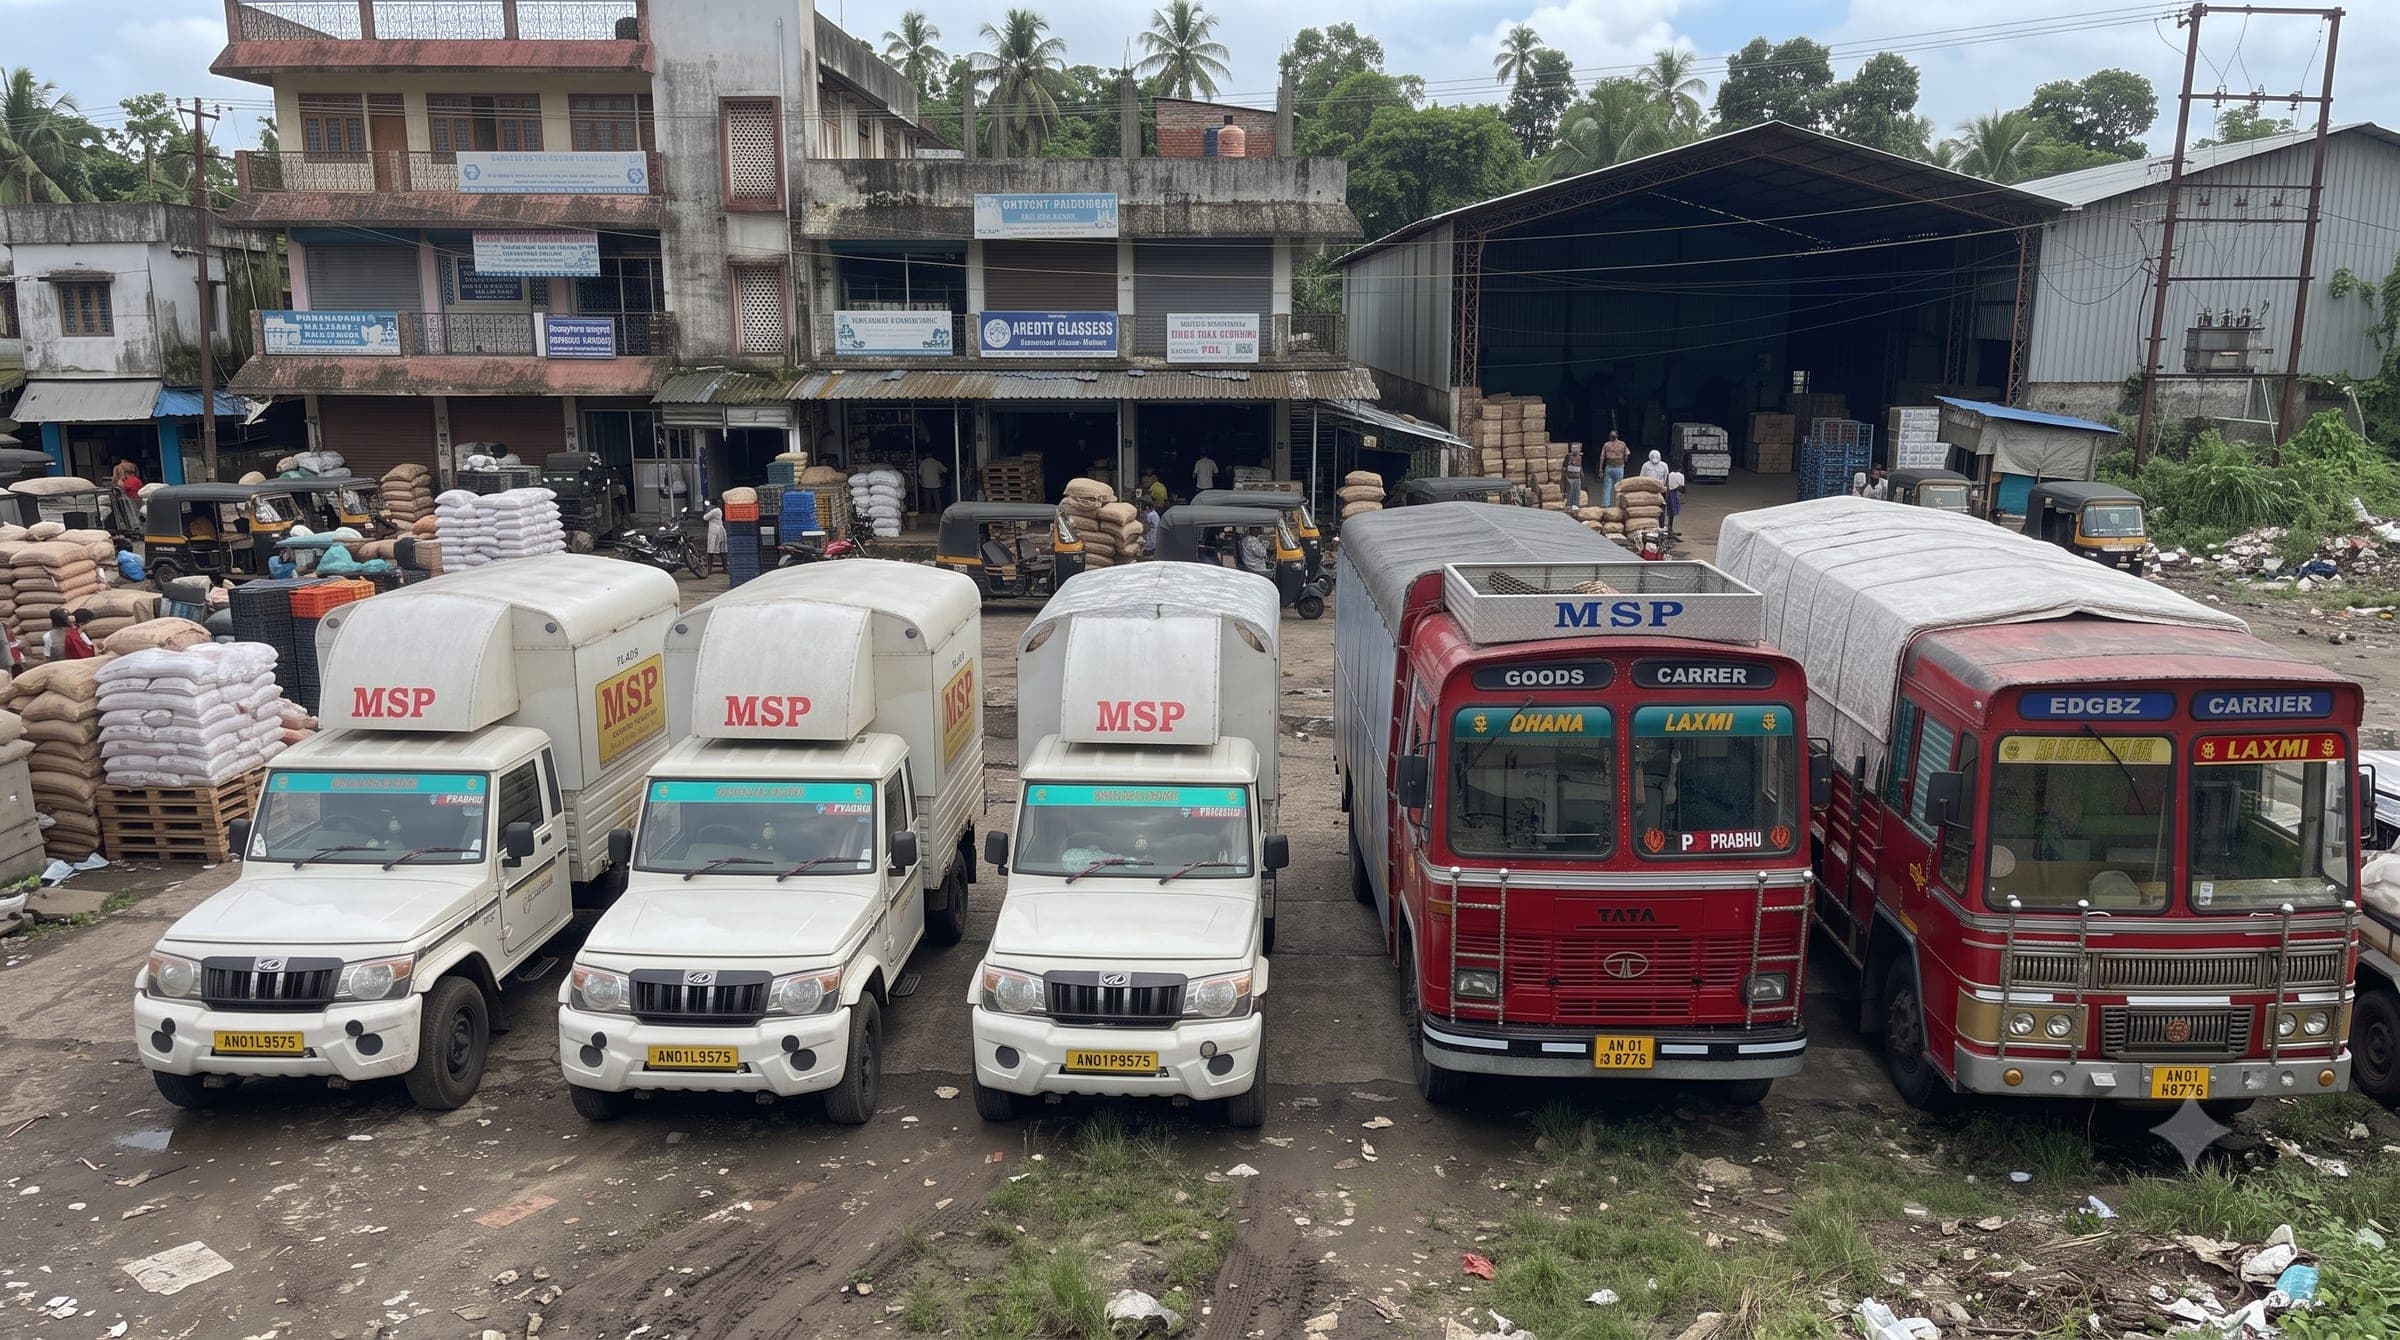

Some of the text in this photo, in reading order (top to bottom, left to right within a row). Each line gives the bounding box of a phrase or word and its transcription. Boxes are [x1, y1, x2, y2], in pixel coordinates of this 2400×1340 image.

[1554, 601, 1684, 628] MSP
[1505, 668, 1747, 685] GOODS CARRER
[351, 687, 436, 718] MSP
[602, 665, 659, 731] MSP
[945, 670, 972, 734] MSP
[2050, 696, 2313, 715] EDGBZ CARRIER
[724, 695, 812, 728] MSP
[1096, 700, 1186, 733] MSP
[1509, 712, 1735, 733] DHANA LAXMI
[2226, 739, 2310, 760] LAXMI
[1681, 831, 1762, 851] P PRABHU
[1599, 908, 1657, 923] TATA
[1608, 1040, 1624, 1051] AN
[1615, 1053, 1647, 1065] 8776
[2161, 1083, 2204, 1096] H8776
